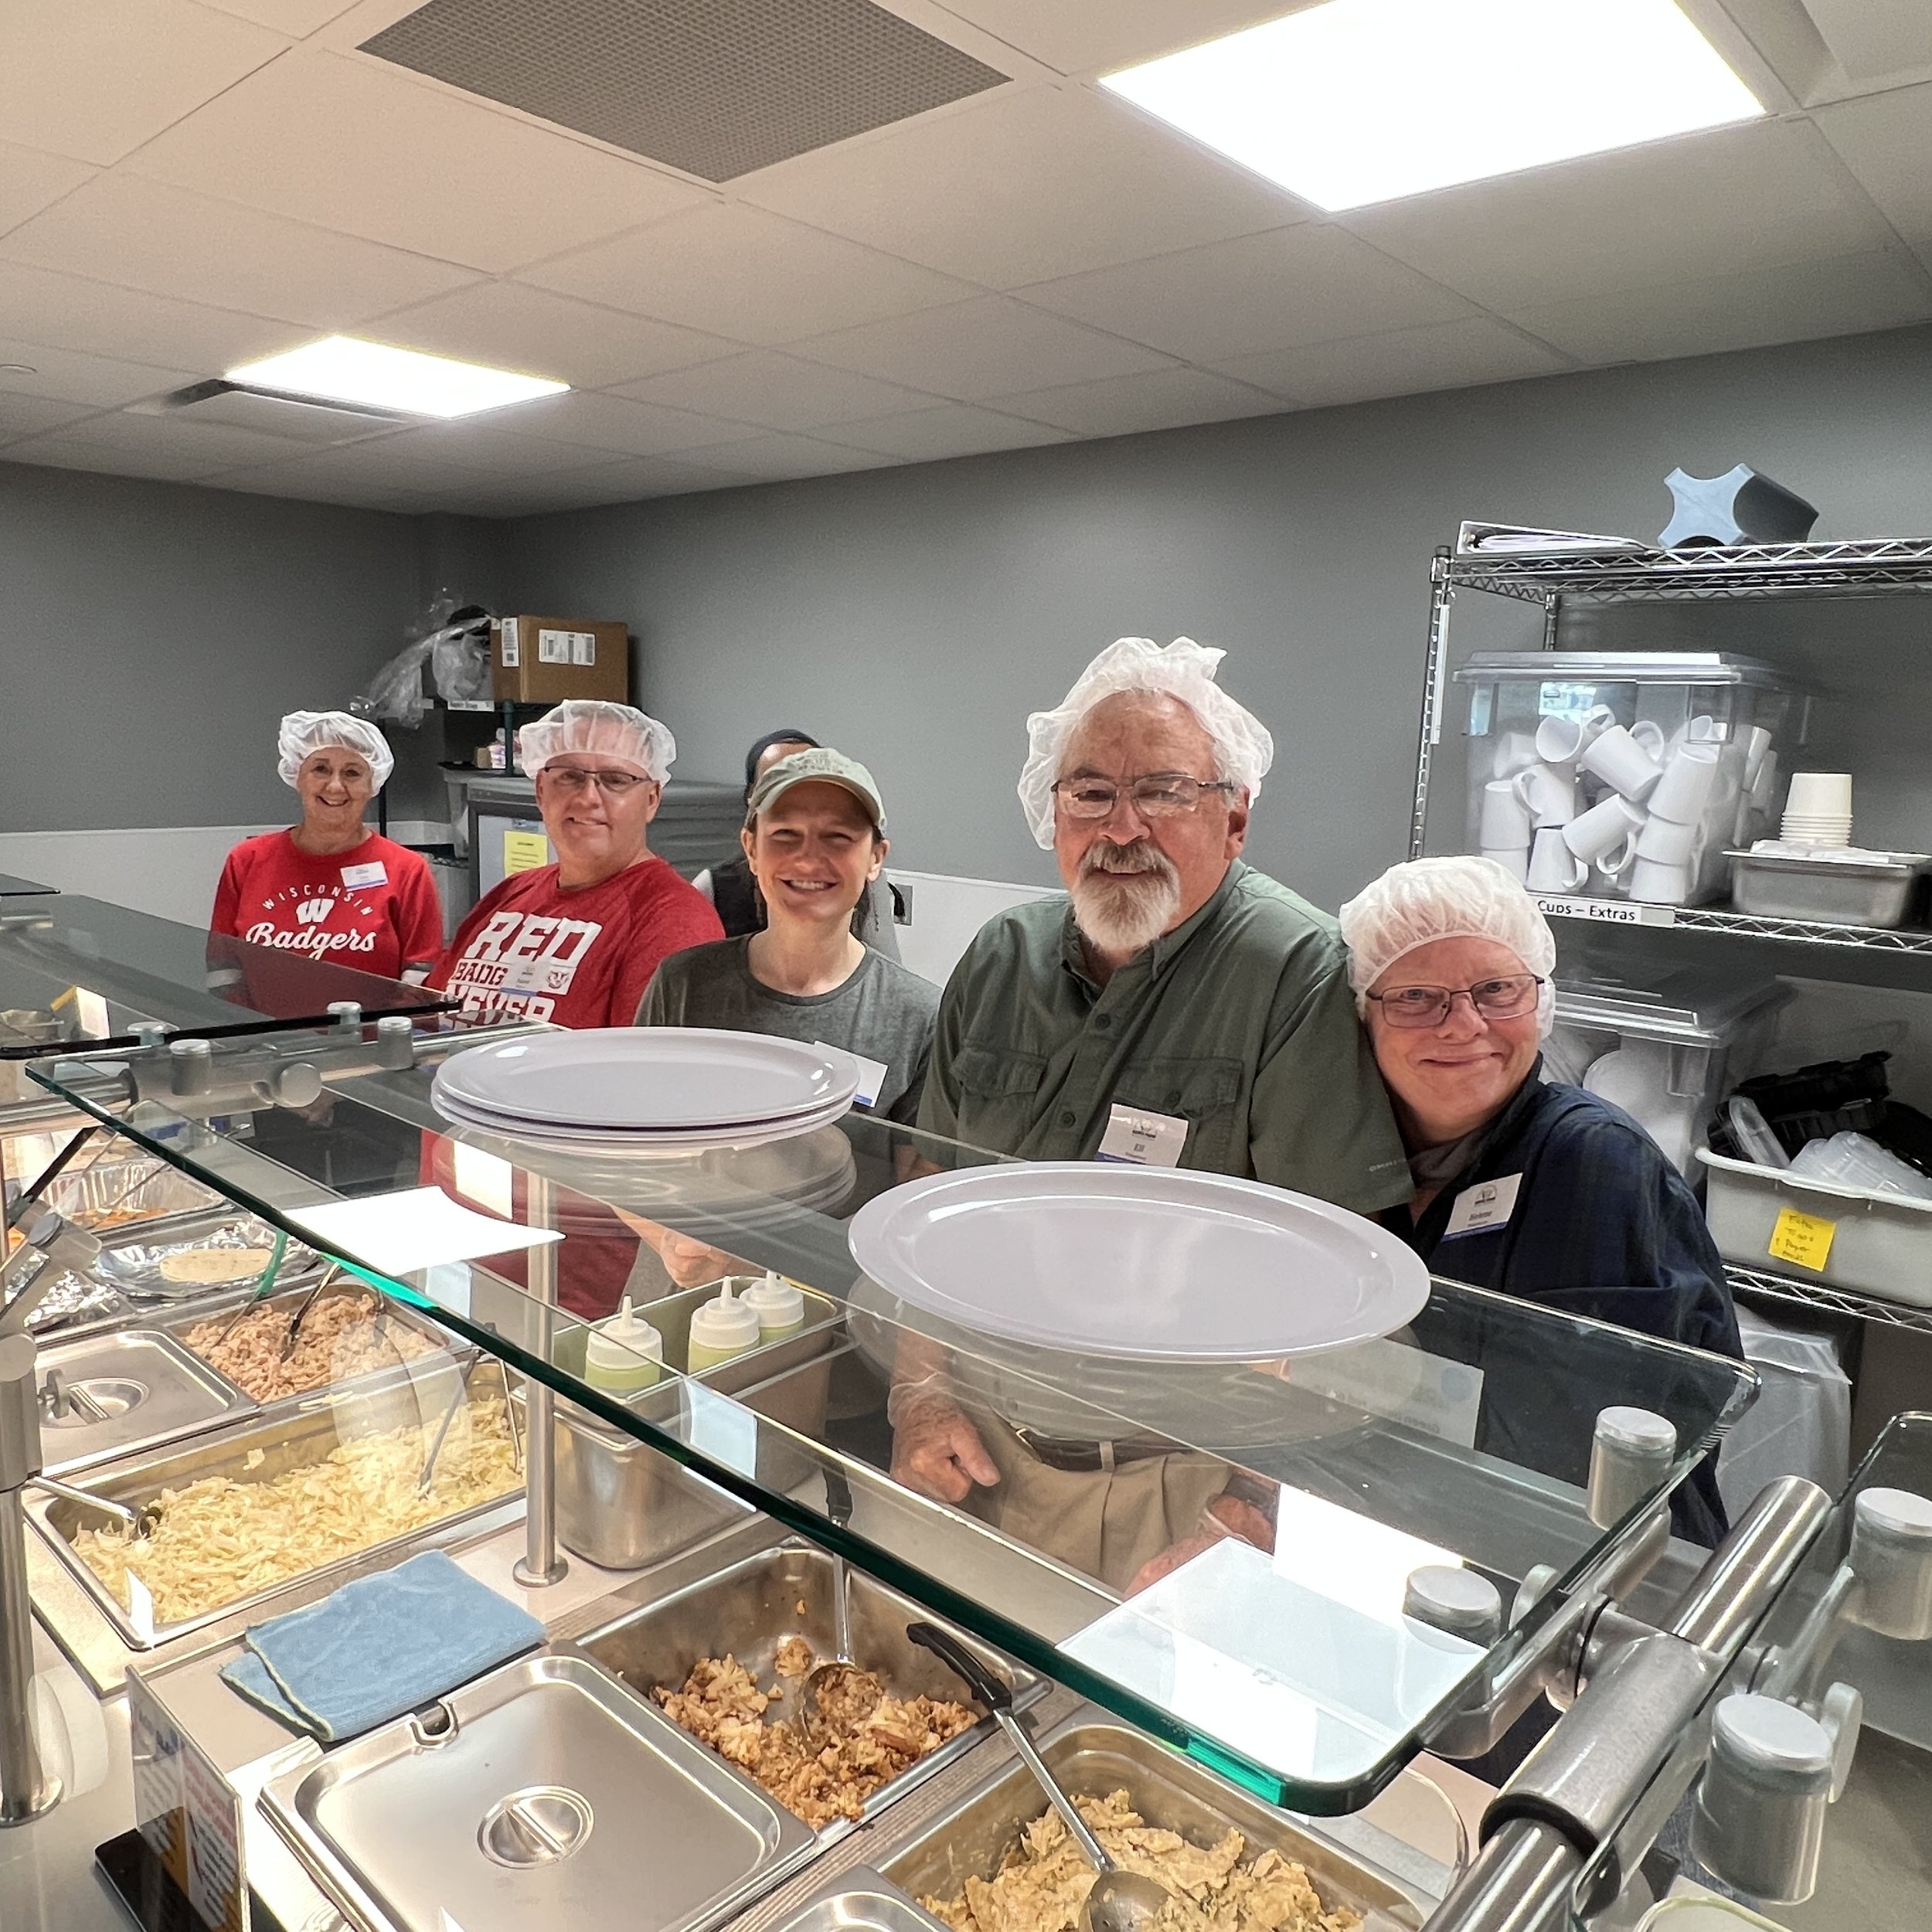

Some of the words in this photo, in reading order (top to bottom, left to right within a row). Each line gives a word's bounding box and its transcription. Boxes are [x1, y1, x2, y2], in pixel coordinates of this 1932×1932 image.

[262, 884, 374, 916] WISCONSIN
[295, 898, 335, 925] W
[1537, 900, 1572, 914] Cups
[1589, 905, 1636, 921] Extras
[245, 922, 377, 961] Badgers
[464, 910, 603, 967] RED
[451, 961, 509, 986] BADG
